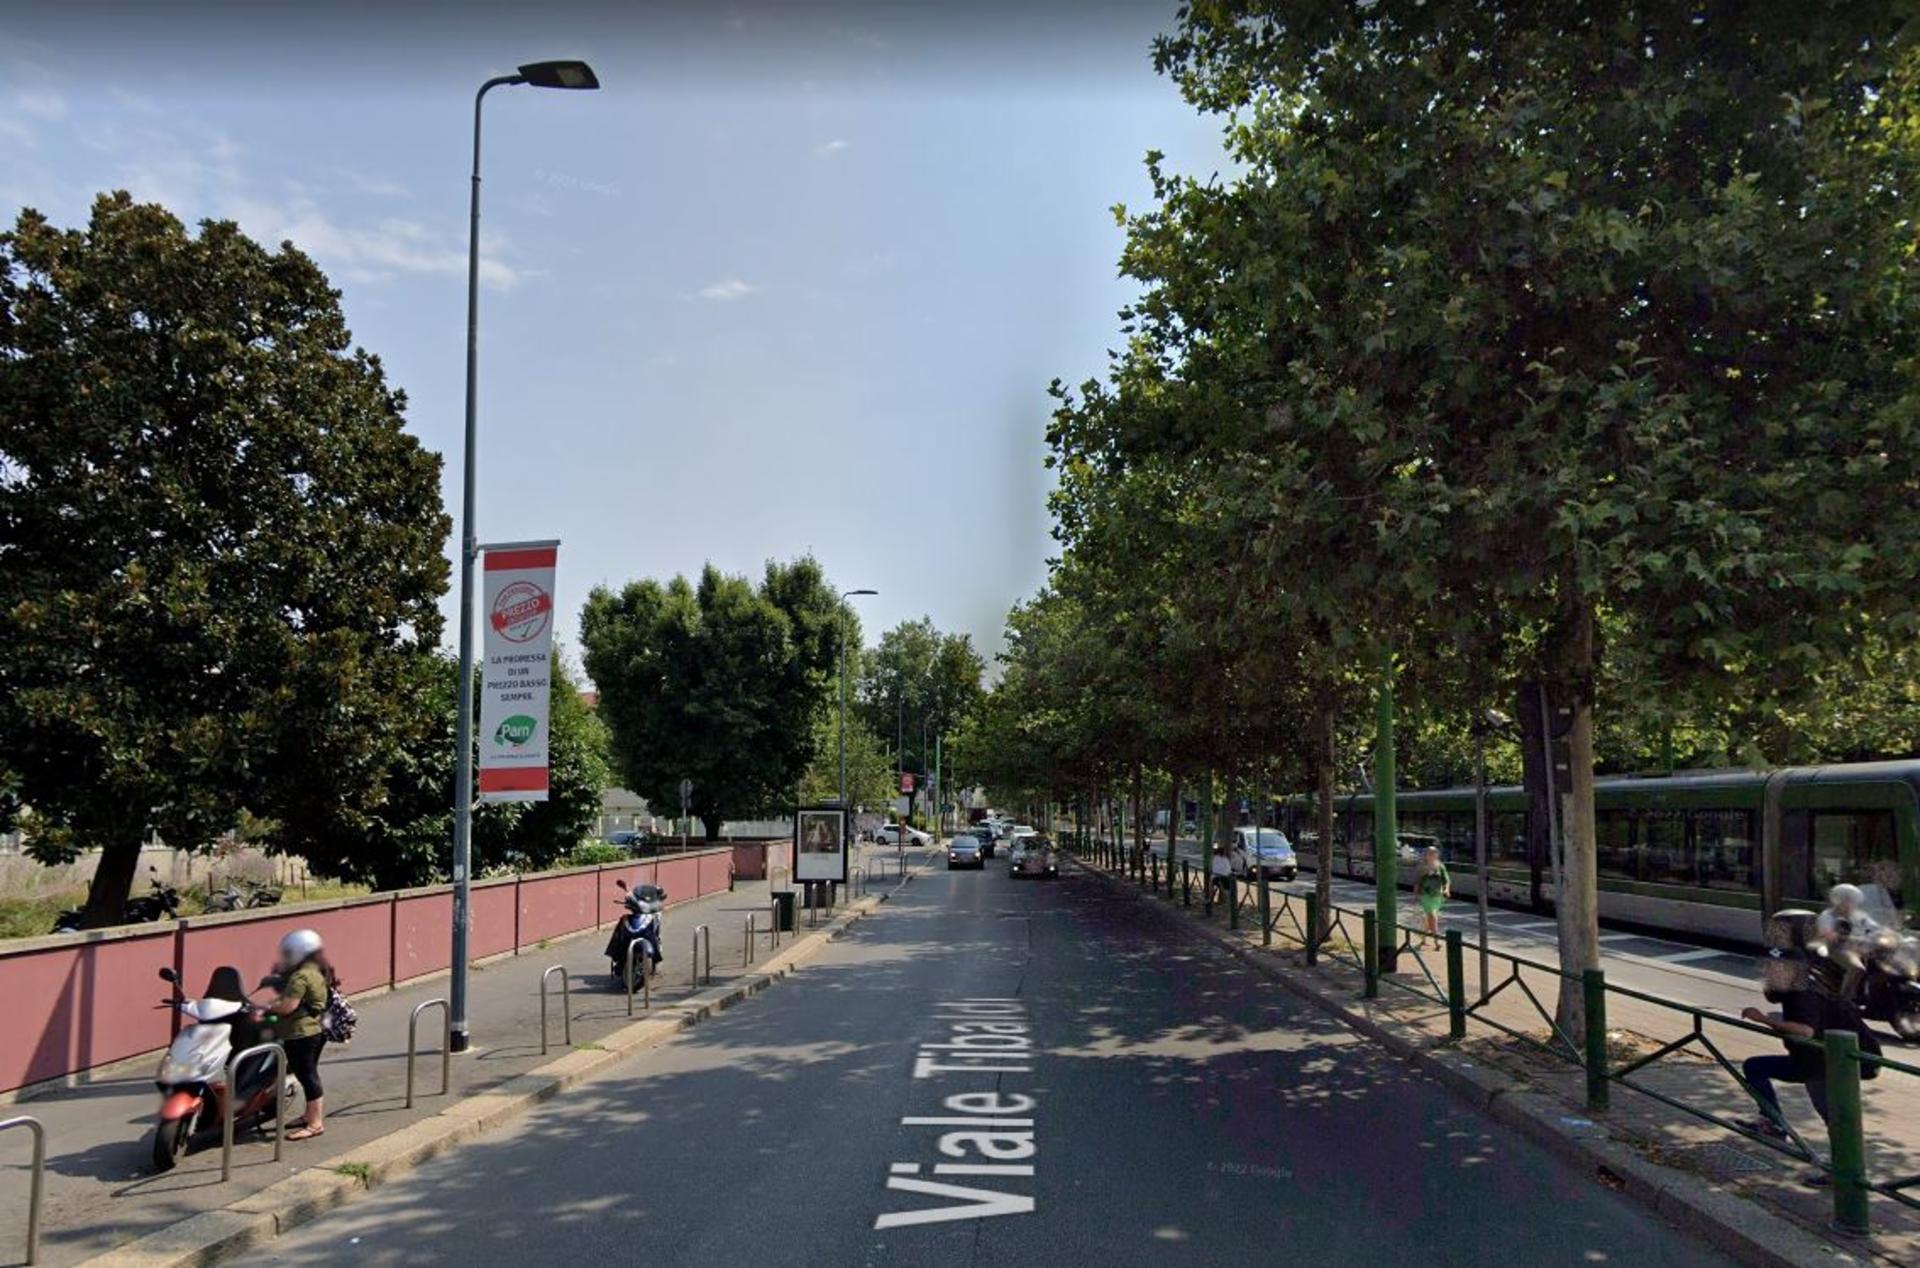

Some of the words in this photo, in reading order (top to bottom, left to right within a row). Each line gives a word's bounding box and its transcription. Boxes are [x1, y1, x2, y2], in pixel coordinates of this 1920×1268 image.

[491, 656, 502, 664] LA
[503, 653, 546, 664] PROMESSA
[507, 668, 516, 676] DI
[518, 667, 529, 675] UN
[487, 680, 518, 689] PREZZO
[502, 724, 530, 737] Pam
